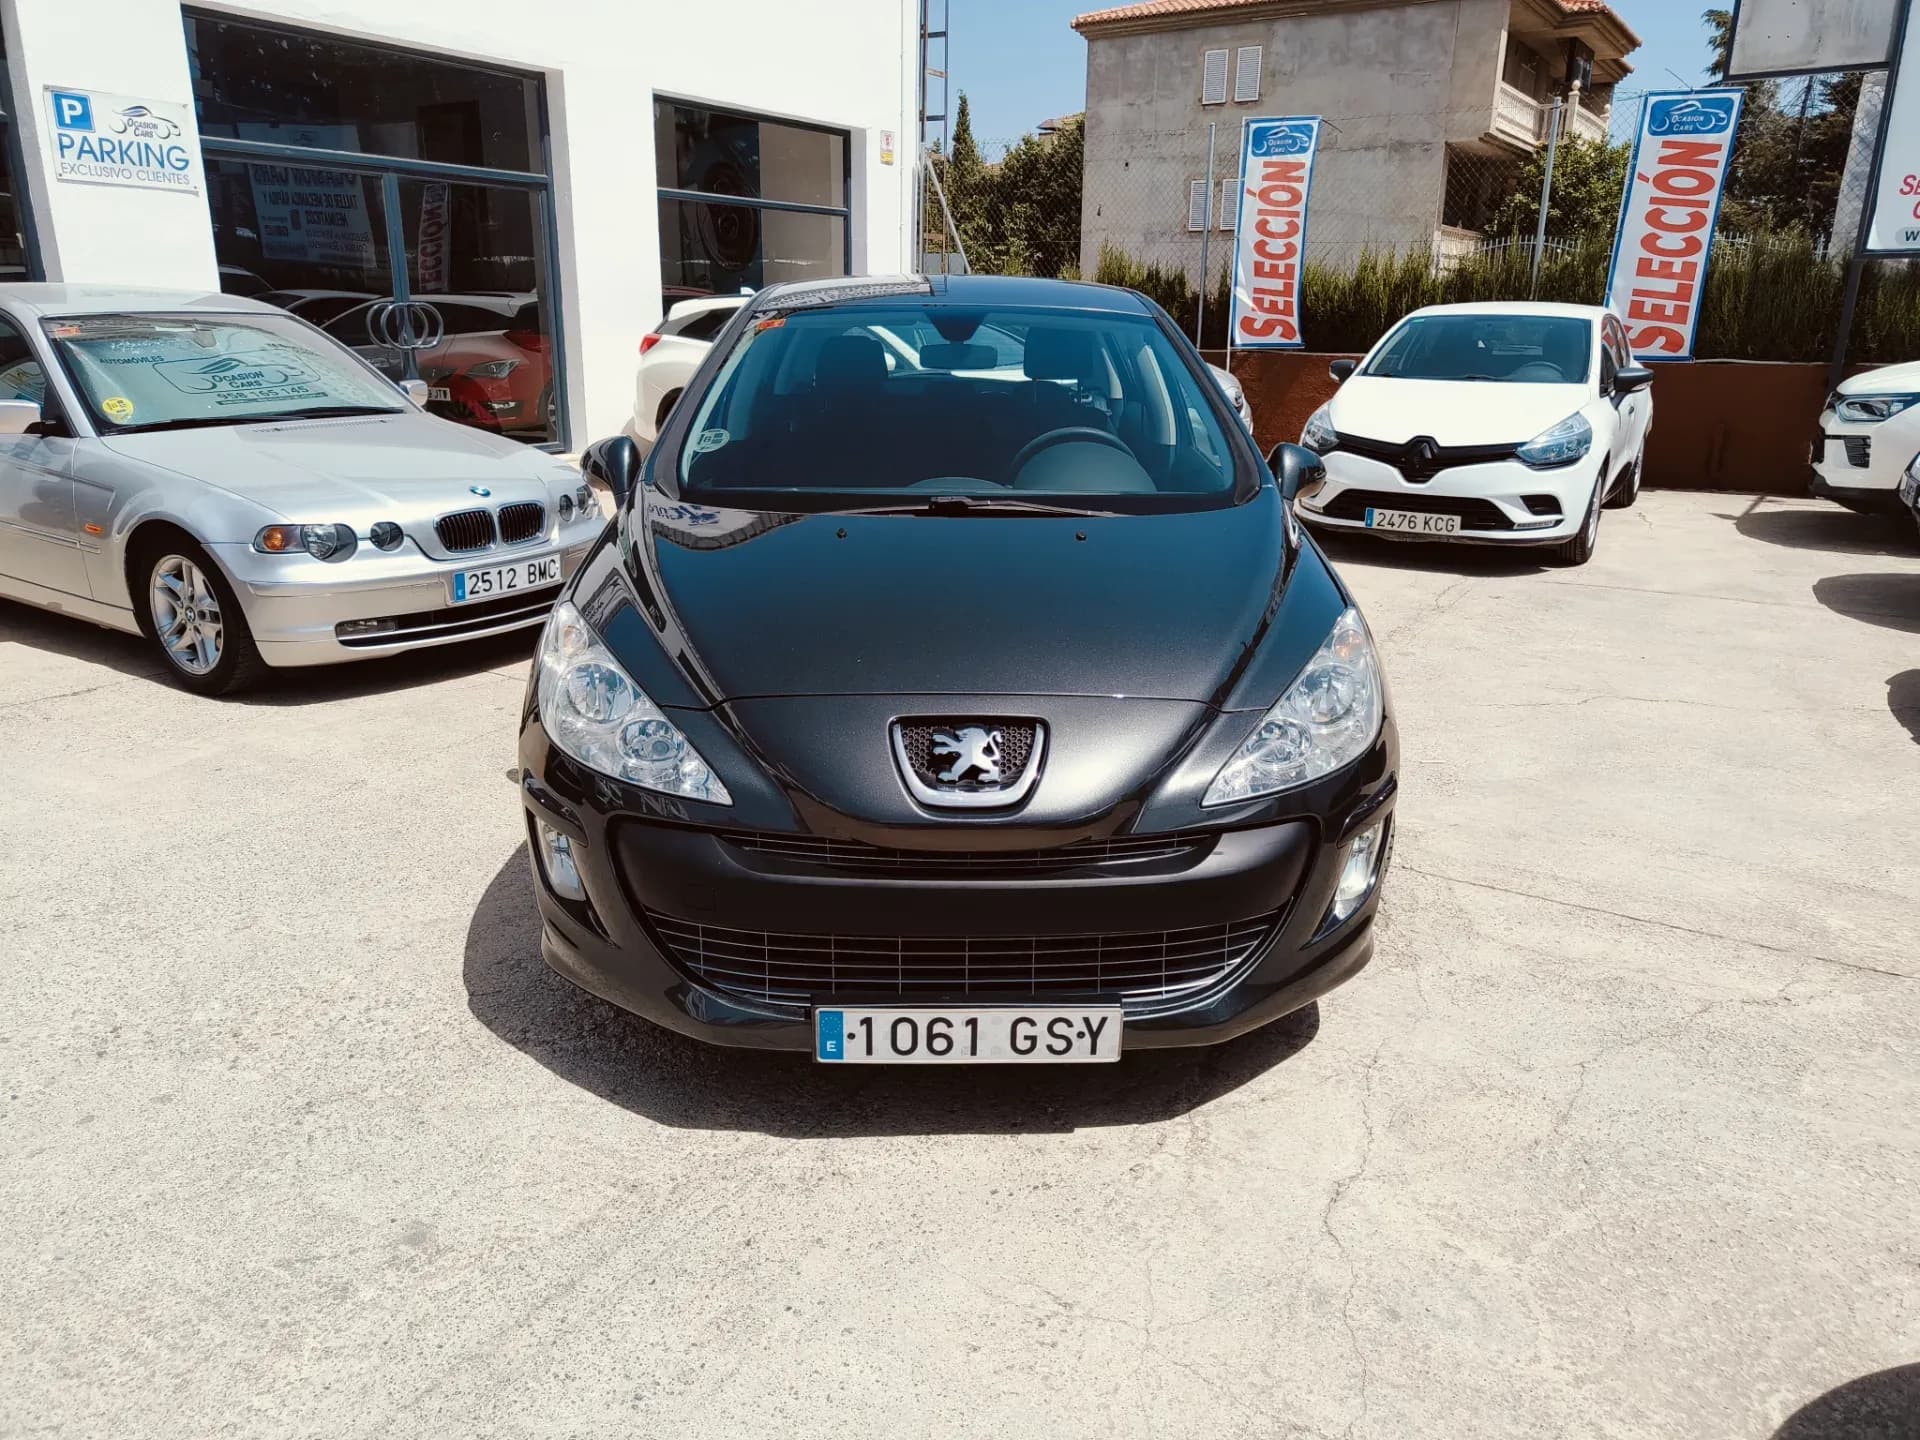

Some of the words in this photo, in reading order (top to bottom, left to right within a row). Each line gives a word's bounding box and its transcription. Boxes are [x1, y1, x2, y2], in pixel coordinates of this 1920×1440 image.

[61, 98, 83, 125] P
[127, 118, 159, 129] OCASION
[134, 127, 154, 138] CARS
[57, 133, 190, 171] PARKING
[60, 162, 133, 180] EXCLUSIVO
[136, 170, 191, 185] CLIENTES
[1240, 160, 1306, 341] SELECCIÓN
[212, 370, 264, 382] OCASION
[229, 380, 262, 389] CARS
[281, 386, 309, 395] 145
[1376, 512, 1418, 530] 2476
[1423, 516, 1455, 532] KCG
[469, 567, 517, 595] 2512
[527, 559, 557, 584] BMC
[859, 1016, 978, 1056] 1061
[1010, 1016, 1108, 1056] GSY
[826, 1041, 836, 1052] E
